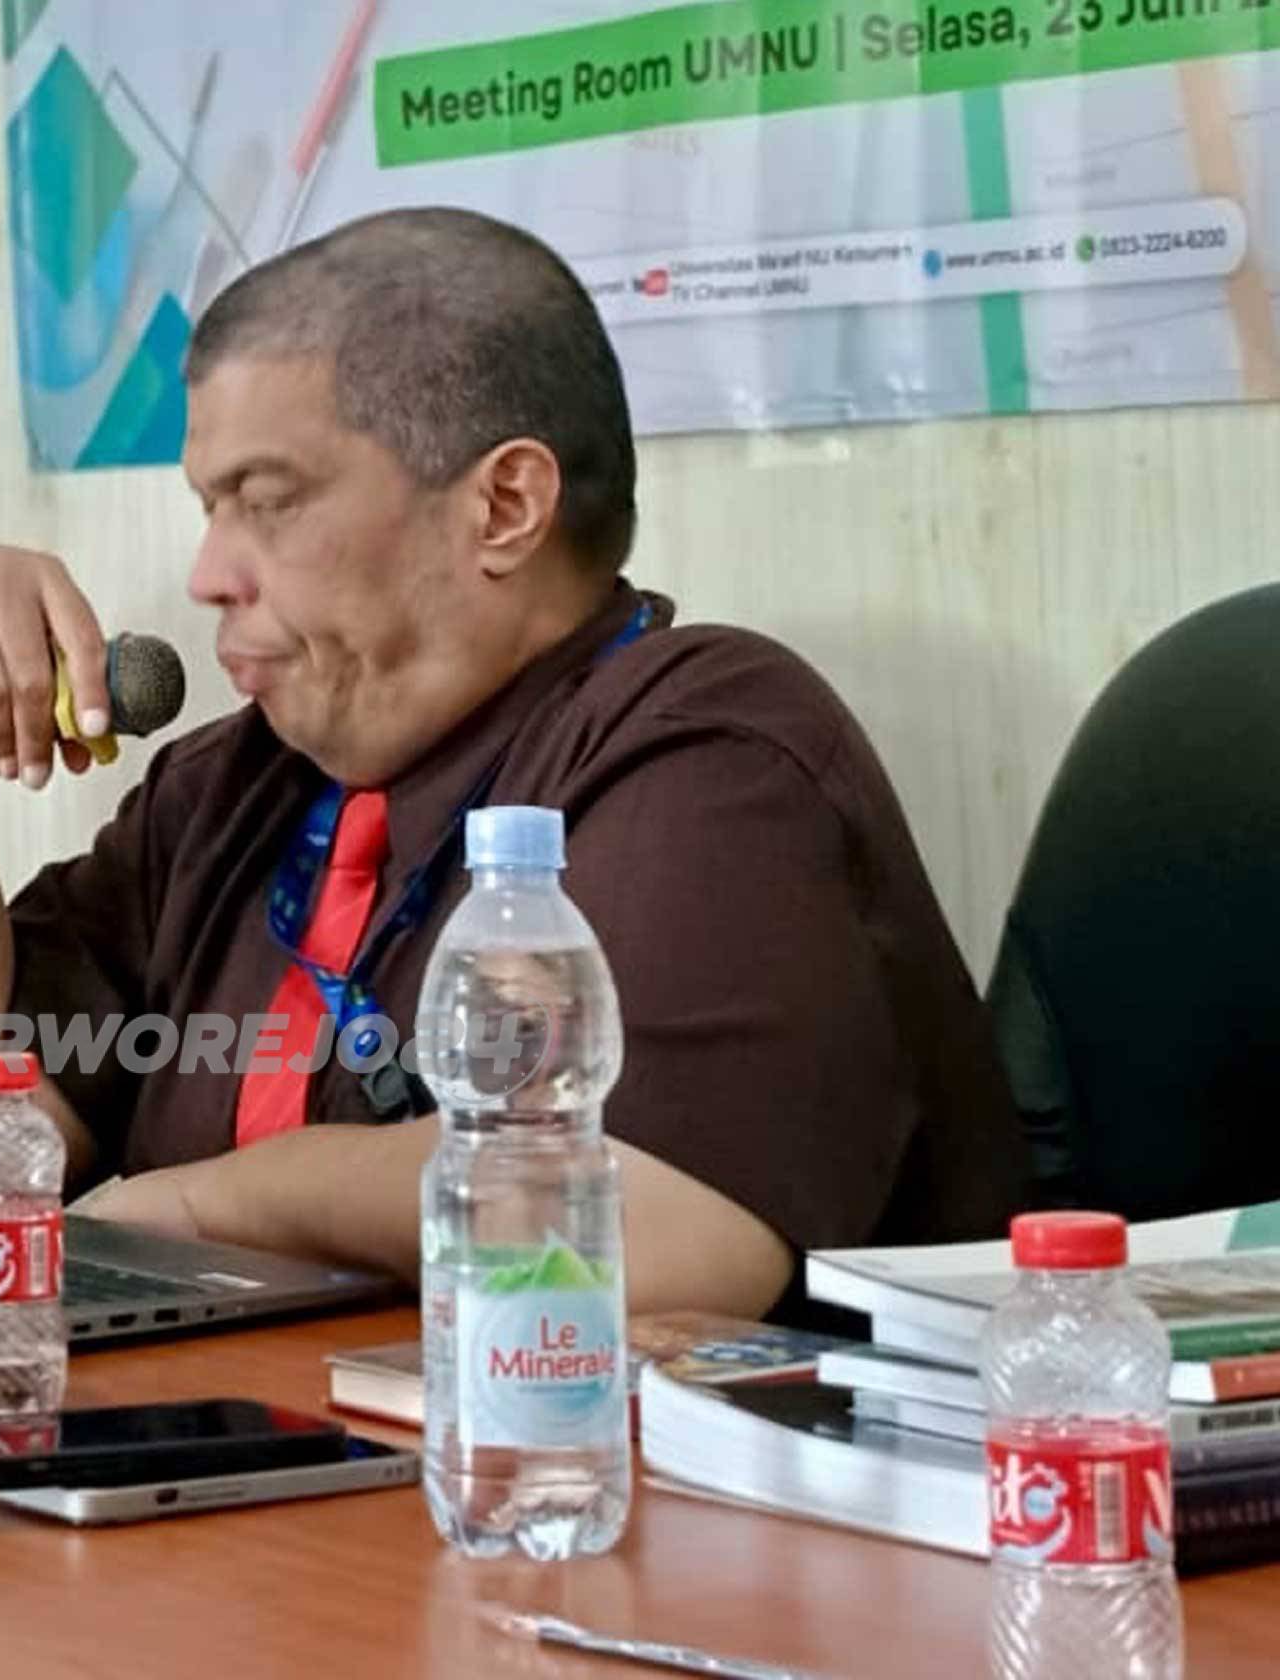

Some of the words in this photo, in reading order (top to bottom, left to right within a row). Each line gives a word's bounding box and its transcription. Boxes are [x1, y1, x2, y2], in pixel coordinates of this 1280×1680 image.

[401, 71, 562, 129] Meeting
[573, 54, 671, 105] Room
[685, 23, 818, 82] UMNU
[861, 5, 1030, 60] Selasa,
[540, 1317, 577, 1350] Le
